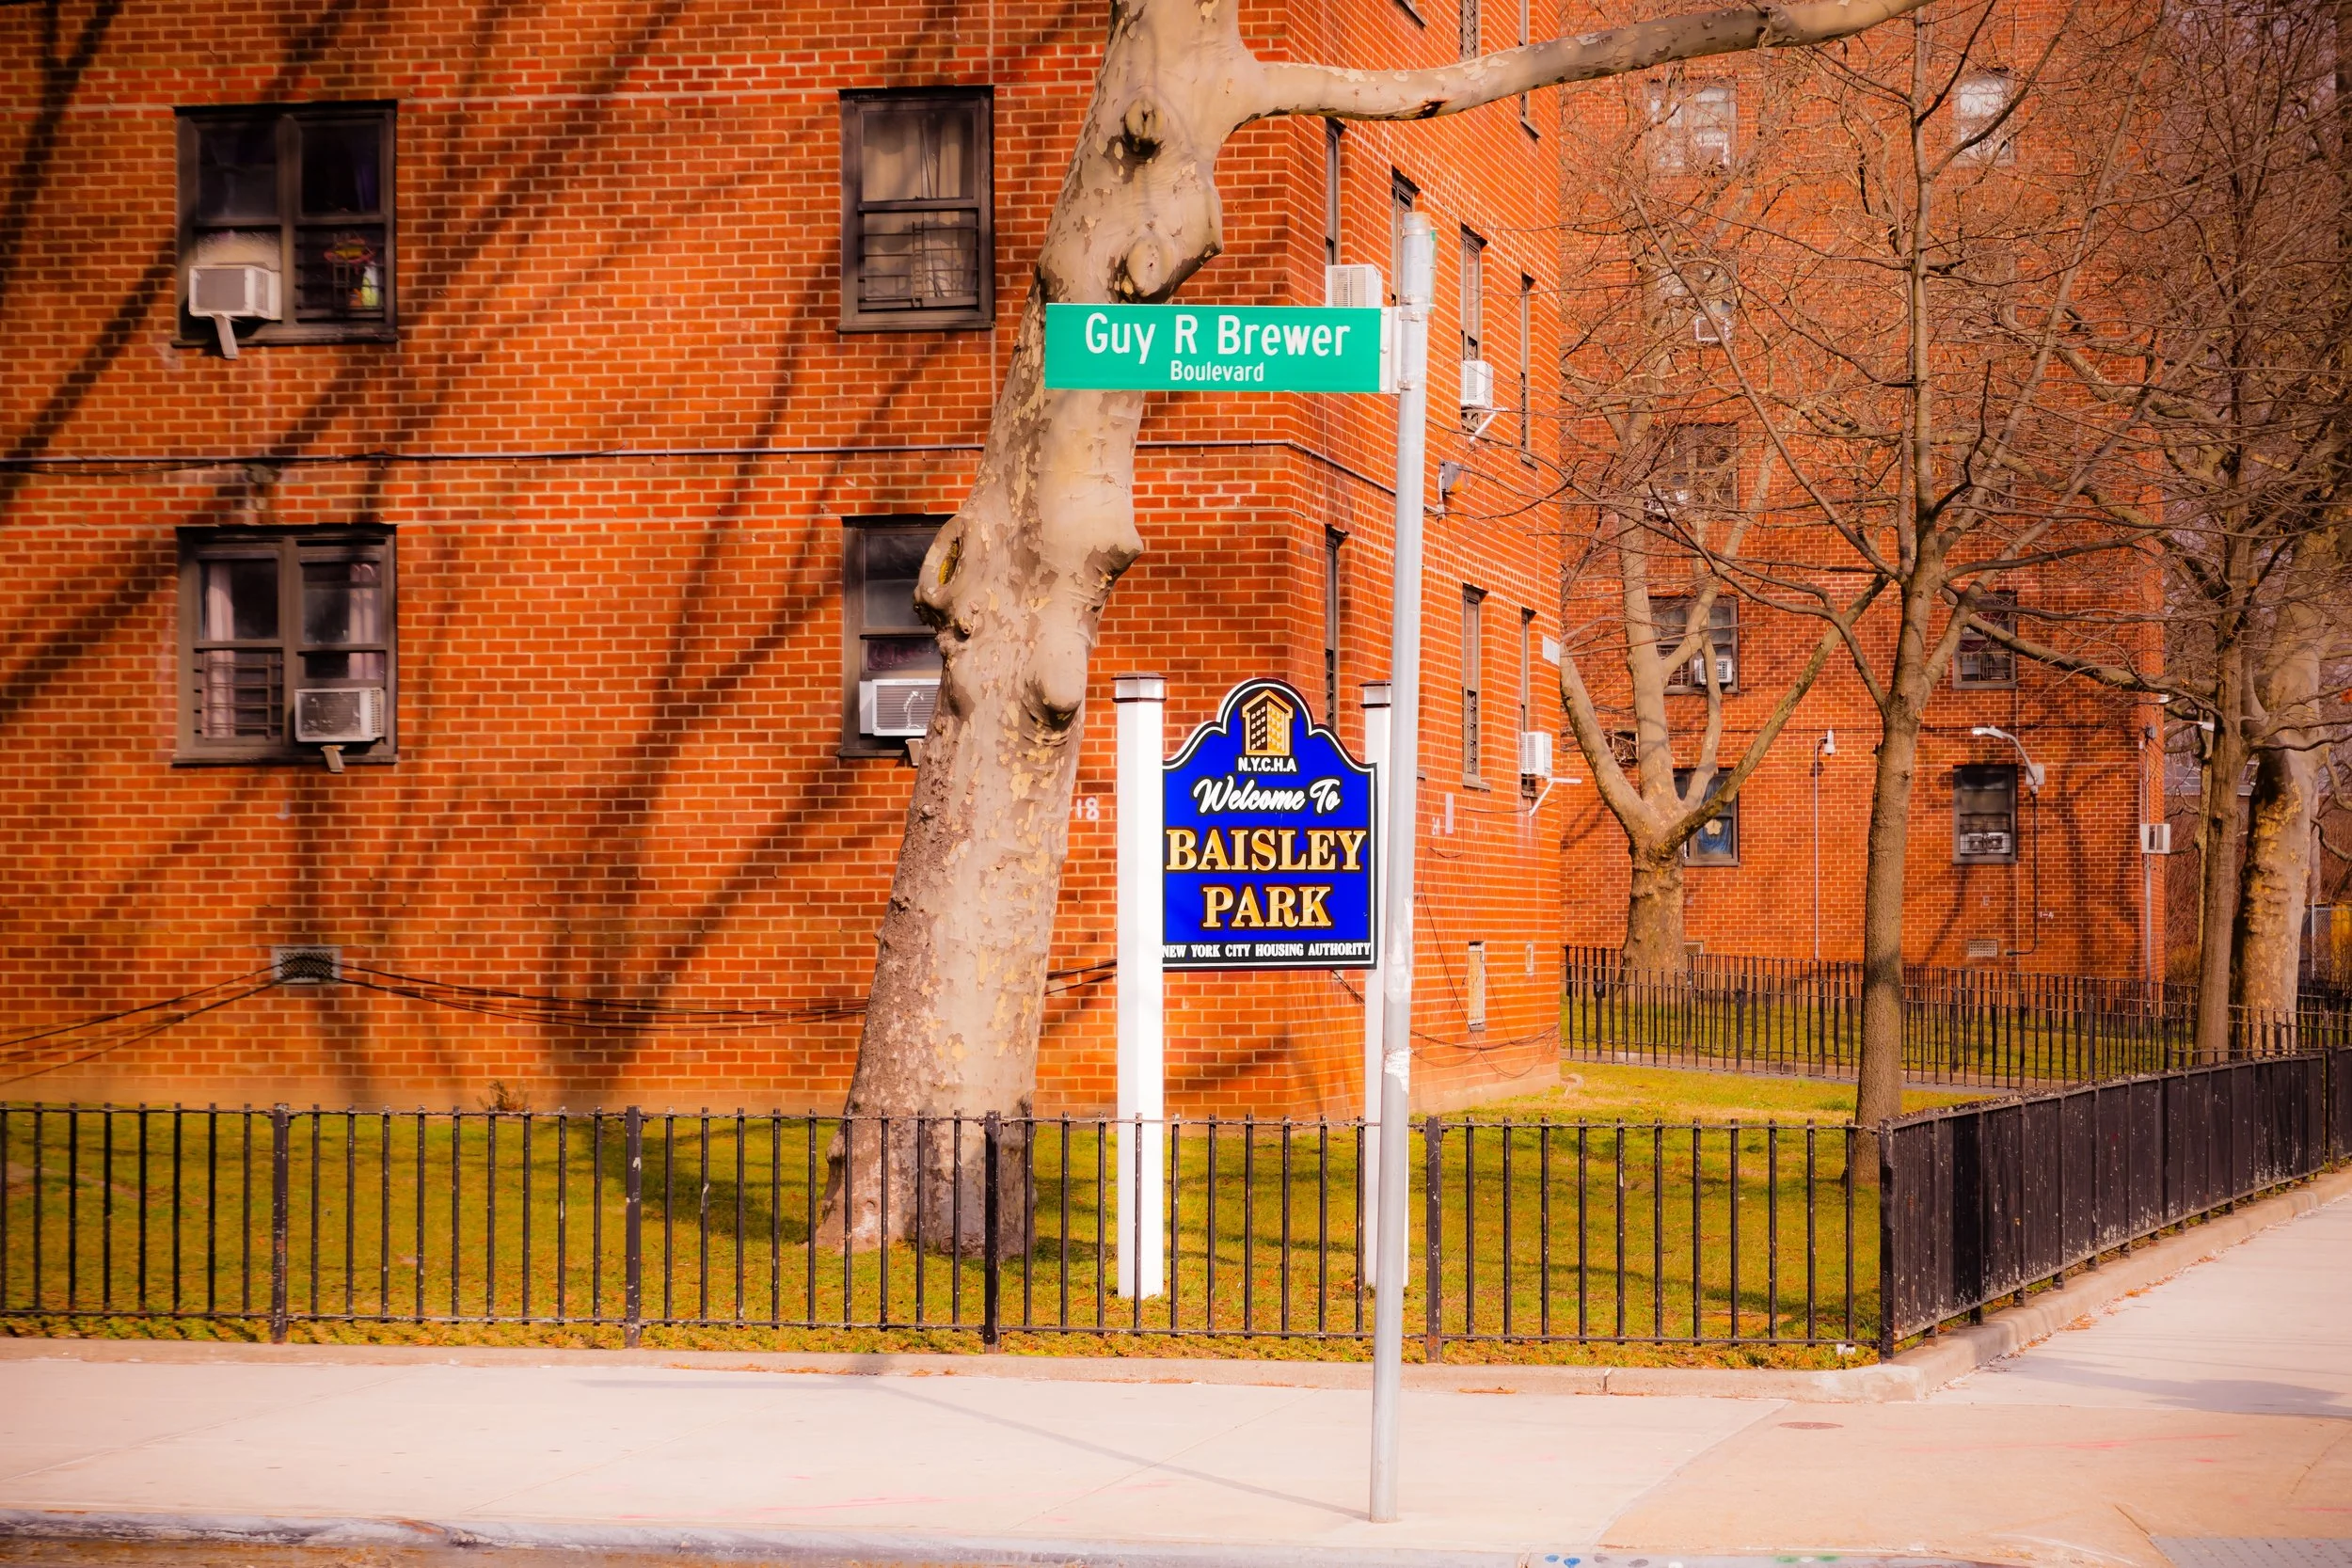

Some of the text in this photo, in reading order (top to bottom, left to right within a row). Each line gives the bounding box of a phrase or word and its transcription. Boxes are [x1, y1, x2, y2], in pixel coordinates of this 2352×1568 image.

[1085, 311, 1351, 364] Guy R Brewer
[1170, 360, 1264, 382] Boulevard
[1237, 756, 1297, 772] N.Y.C.H.A
[1193, 775, 1341, 814] Welcome To
[1166, 829, 1367, 871] BAISLEY
[1202, 886, 1332, 927] PARK
[1160, 942, 1371, 958] NEW YORK CITY HOUSING AUTHORITY
